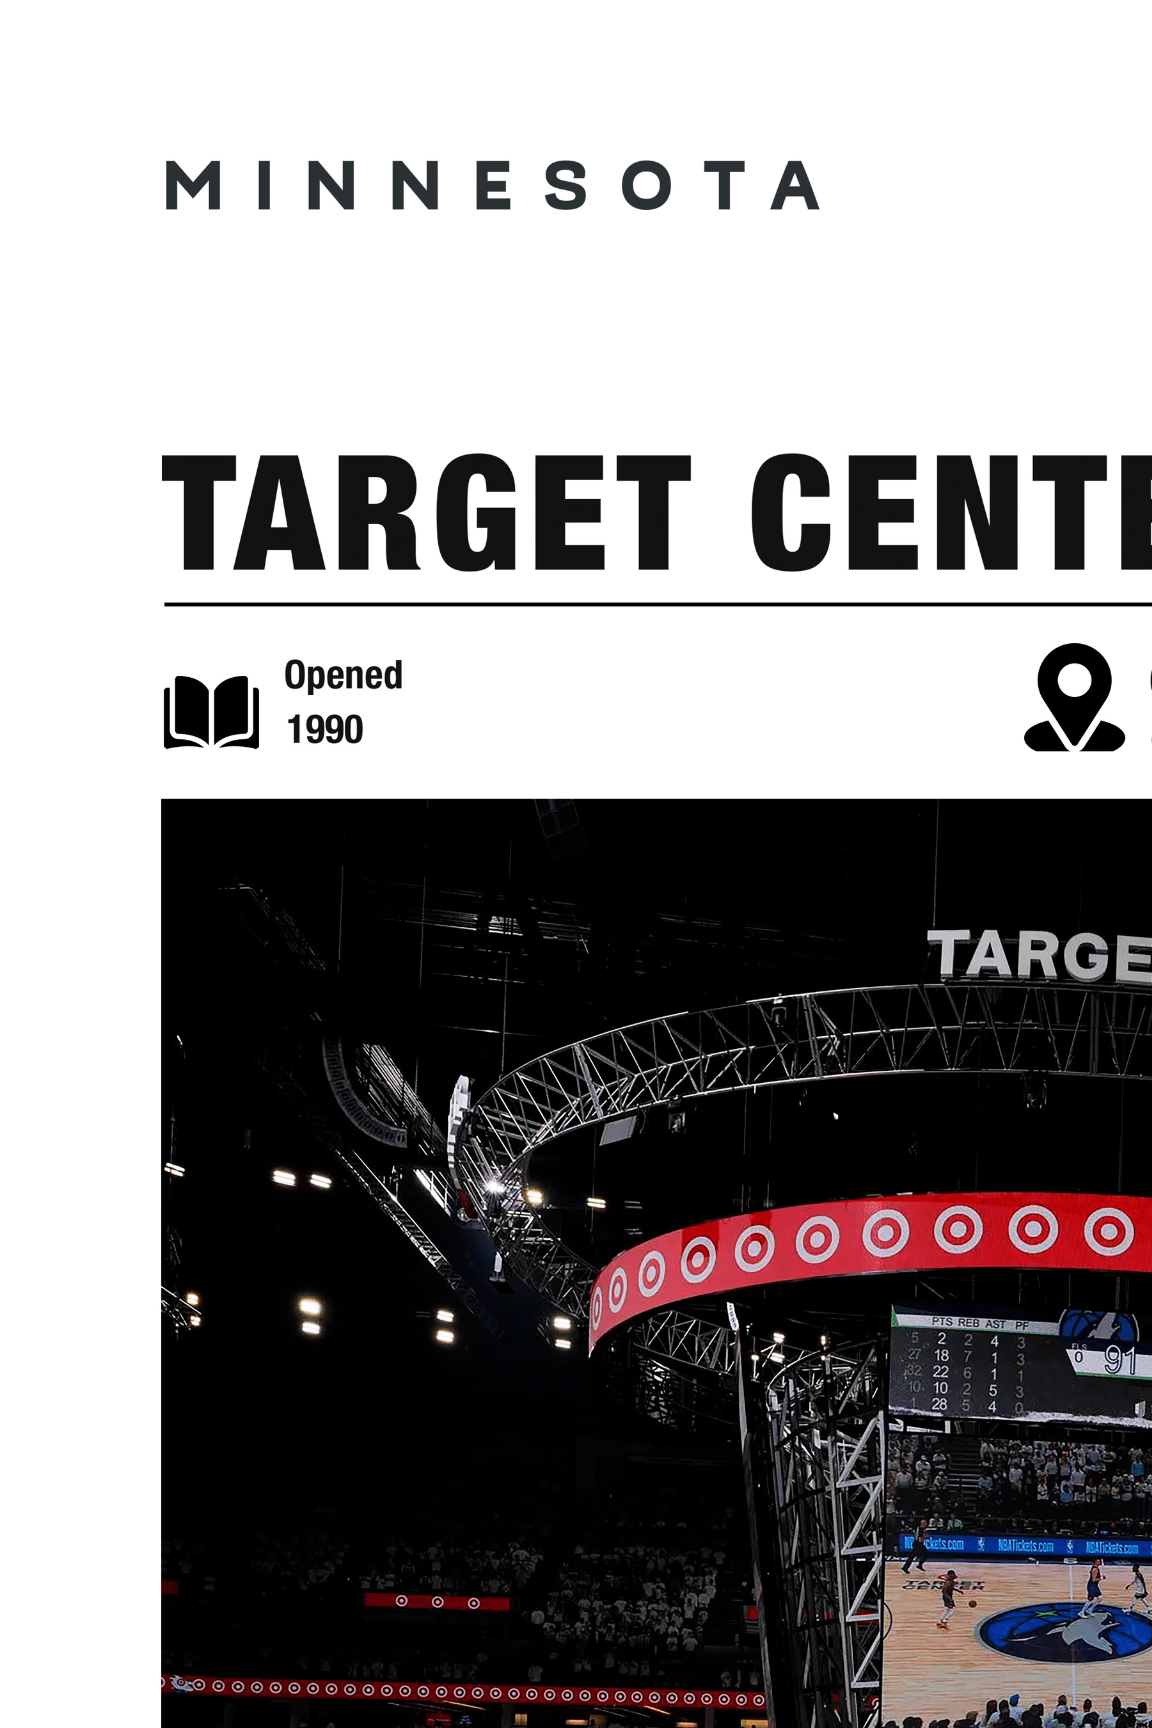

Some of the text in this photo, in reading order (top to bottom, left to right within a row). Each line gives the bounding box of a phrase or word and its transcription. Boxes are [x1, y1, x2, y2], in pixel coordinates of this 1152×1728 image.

[932, 1317, 1029, 1331] PTS REB AST PF
[937, 1332, 999, 1347] 2 4
[934, 1349, 949, 1361] 18
[1074, 1344, 1137, 1375] 0 91
[932, 1366, 949, 1378] 22
[933, 1382, 998, 1397] 10 5
[932, 1398, 997, 1413] 28 4
[998, 1539, 1054, 1553] NBATickets.com
[1086, 1541, 1139, 1555] NBATickets.com
